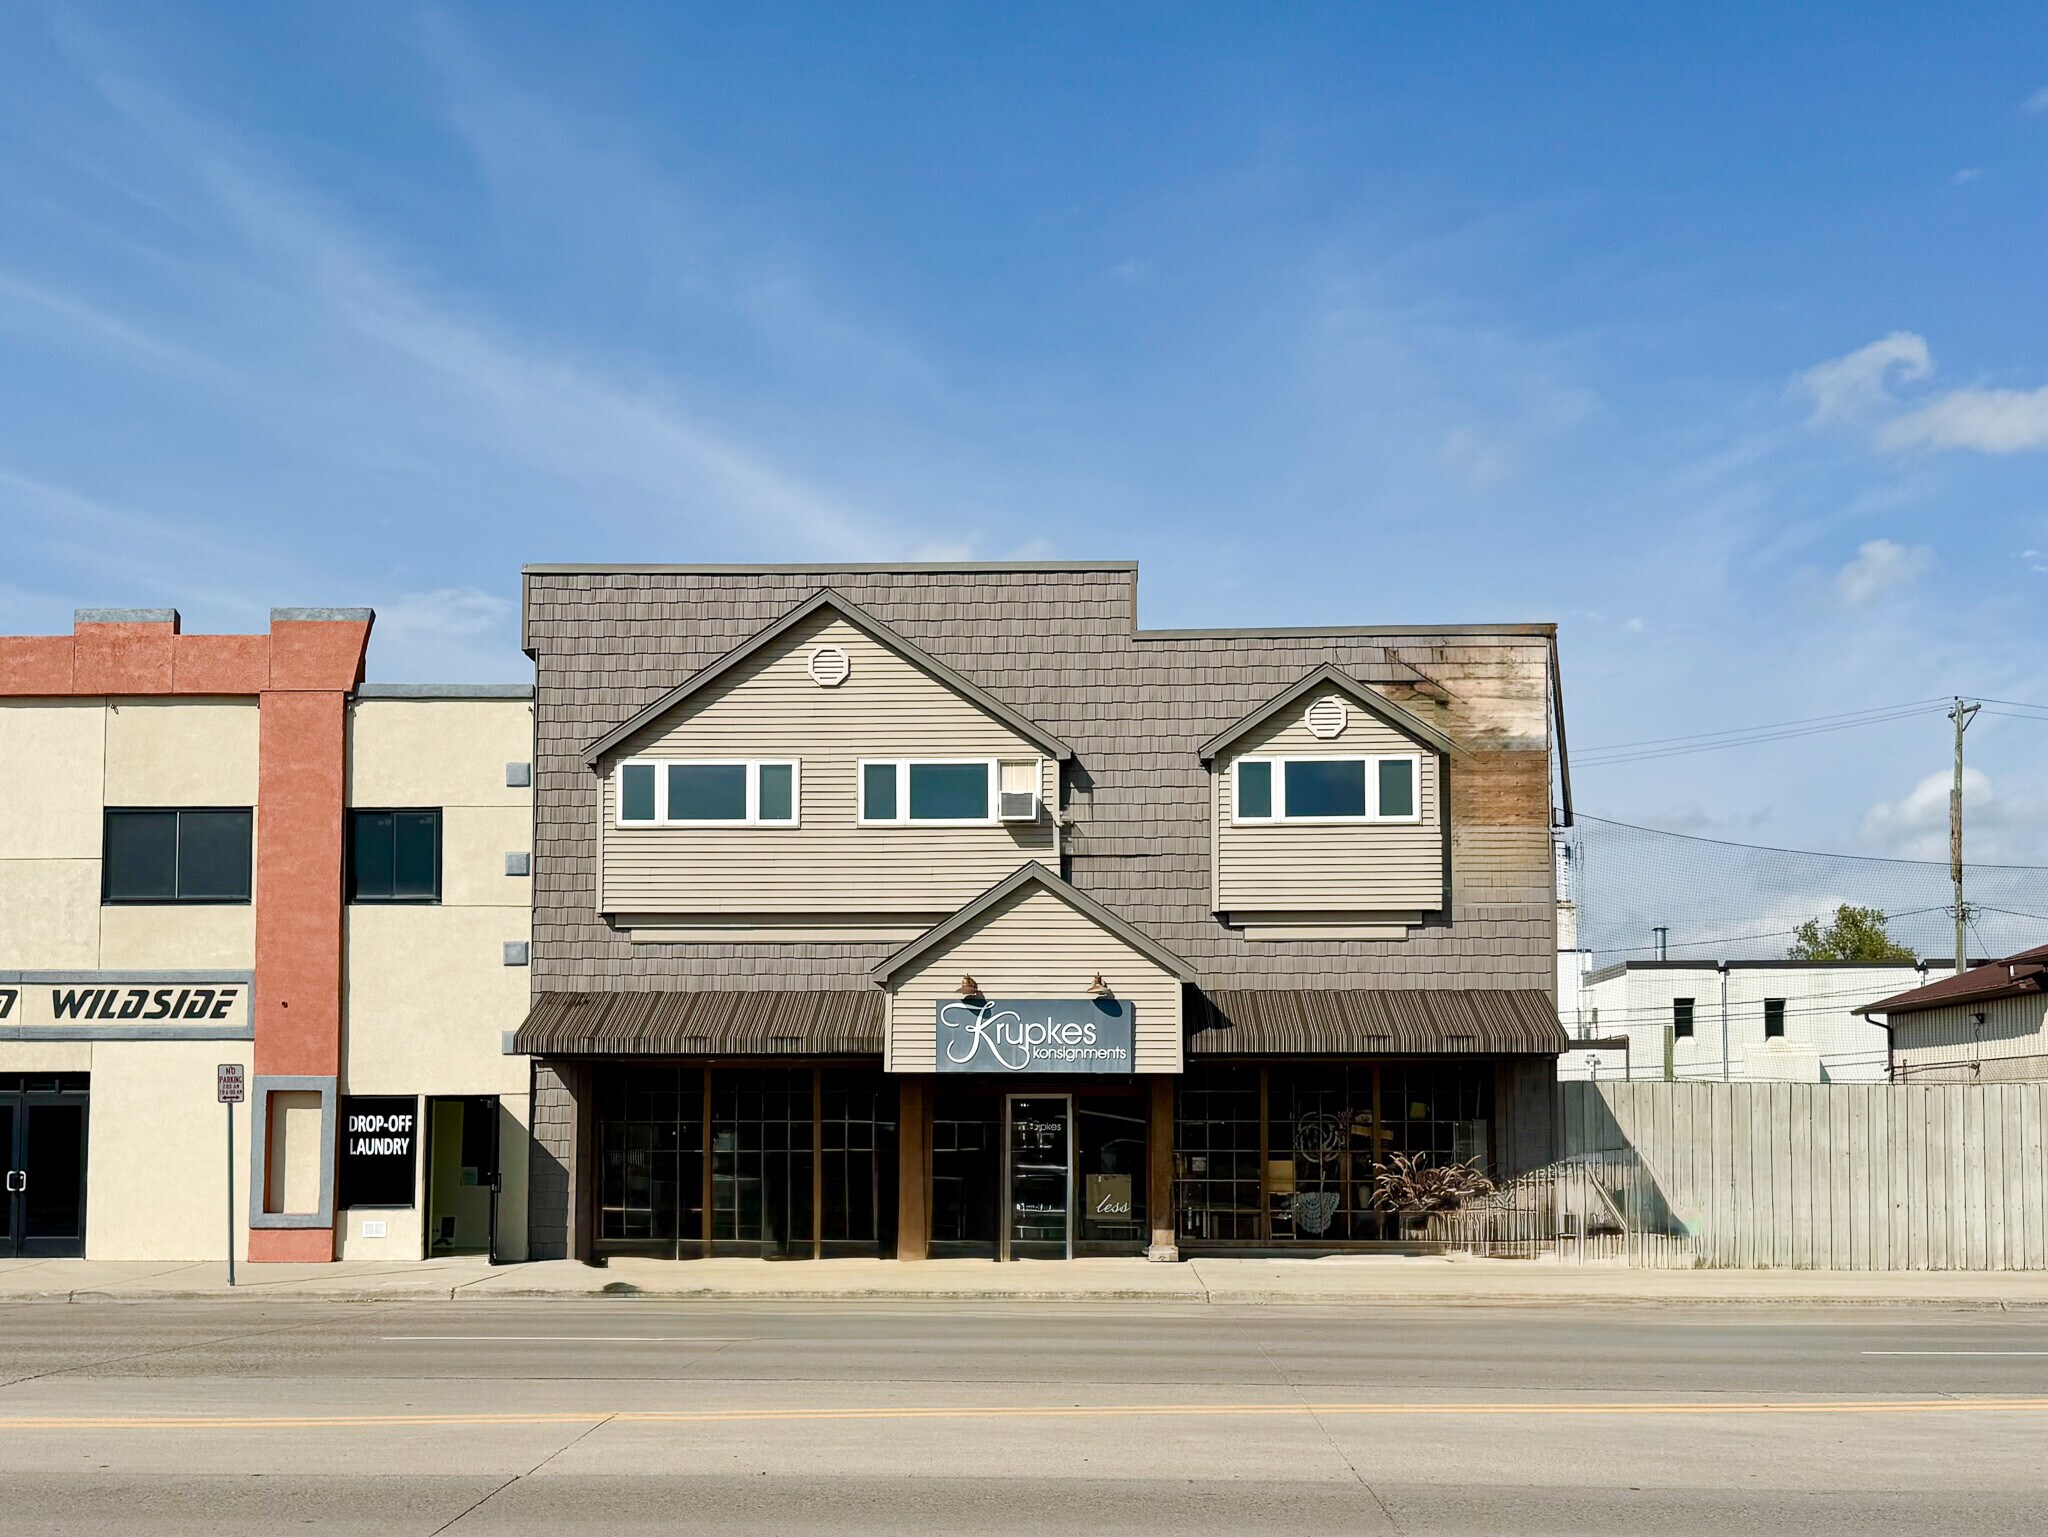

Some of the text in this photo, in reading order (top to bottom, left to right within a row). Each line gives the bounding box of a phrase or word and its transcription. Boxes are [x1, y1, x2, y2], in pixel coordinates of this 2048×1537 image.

[52, 989, 239, 1019] WILDSIDE
[940, 1000, 1097, 1071] Krupkes
[1033, 1046, 1127, 1062] konsignments
[219, 1076, 242, 1084] PARKING
[225, 1066, 236, 1075] NO
[349, 1114, 413, 1133] DROP-OFF
[350, 1137, 410, 1156] LAUNDRY
